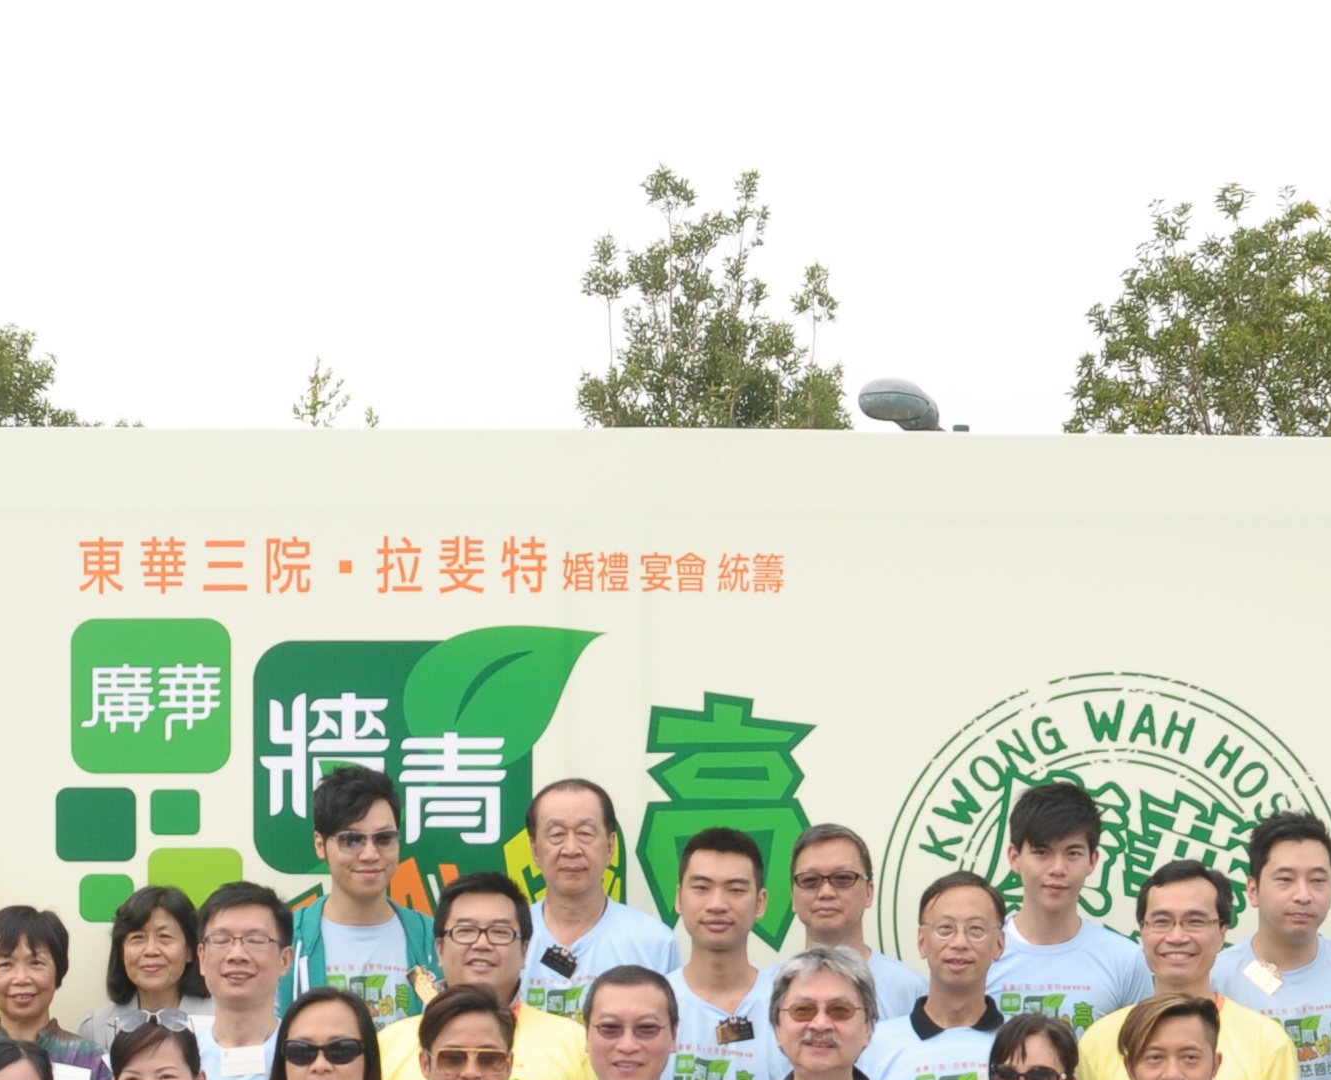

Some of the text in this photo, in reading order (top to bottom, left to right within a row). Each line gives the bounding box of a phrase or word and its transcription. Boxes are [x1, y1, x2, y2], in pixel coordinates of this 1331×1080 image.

[562, 551, 629, 593] 婚禮
[639, 551, 707, 593] 宴會
[717, 551, 785, 593] 統籌
[80, 663, 225, 742] 廣華
[918, 715, 1068, 862] KWONG
[1083, 698, 1197, 756] WAH
